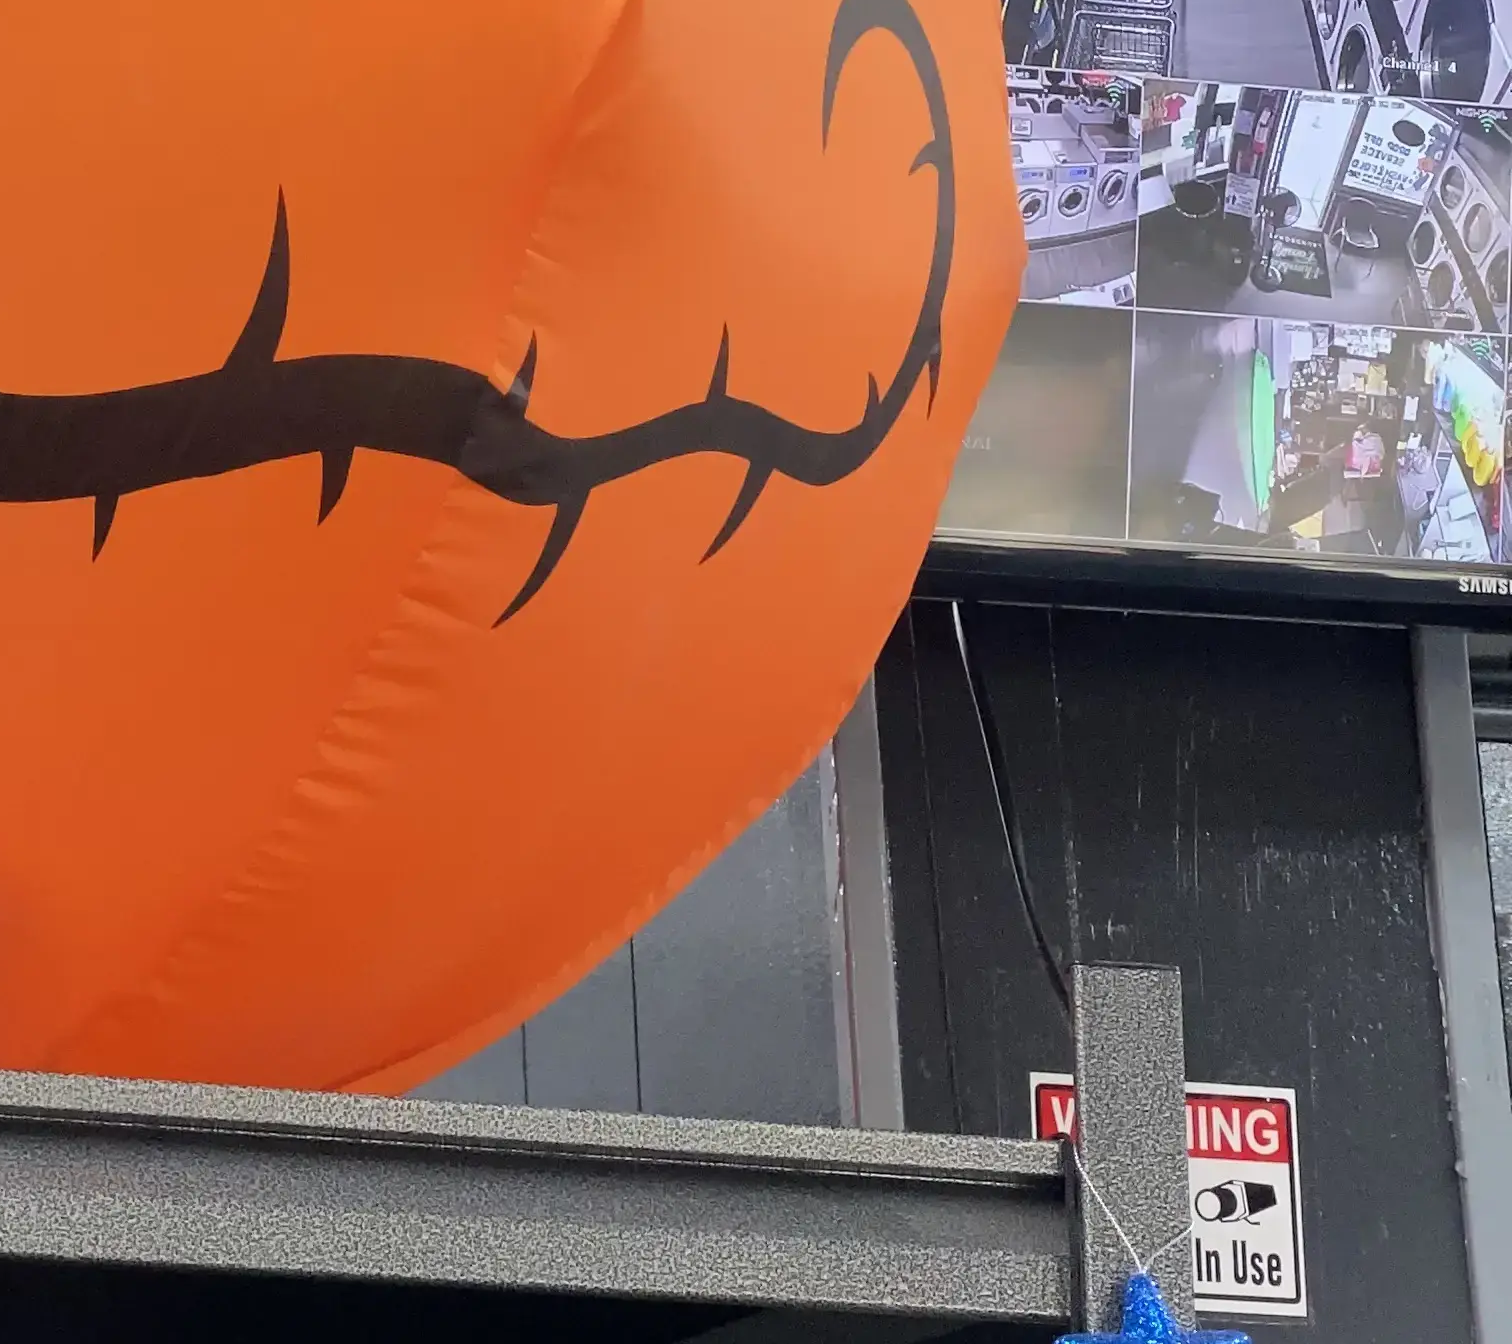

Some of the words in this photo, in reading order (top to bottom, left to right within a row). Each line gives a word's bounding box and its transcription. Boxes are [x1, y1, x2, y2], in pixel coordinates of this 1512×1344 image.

[1383, 56, 1439, 72] Channel
[1448, 61, 1457, 74] 4
[1195, 1237, 1222, 1283] In
[1231, 1239, 1283, 1288] Use
